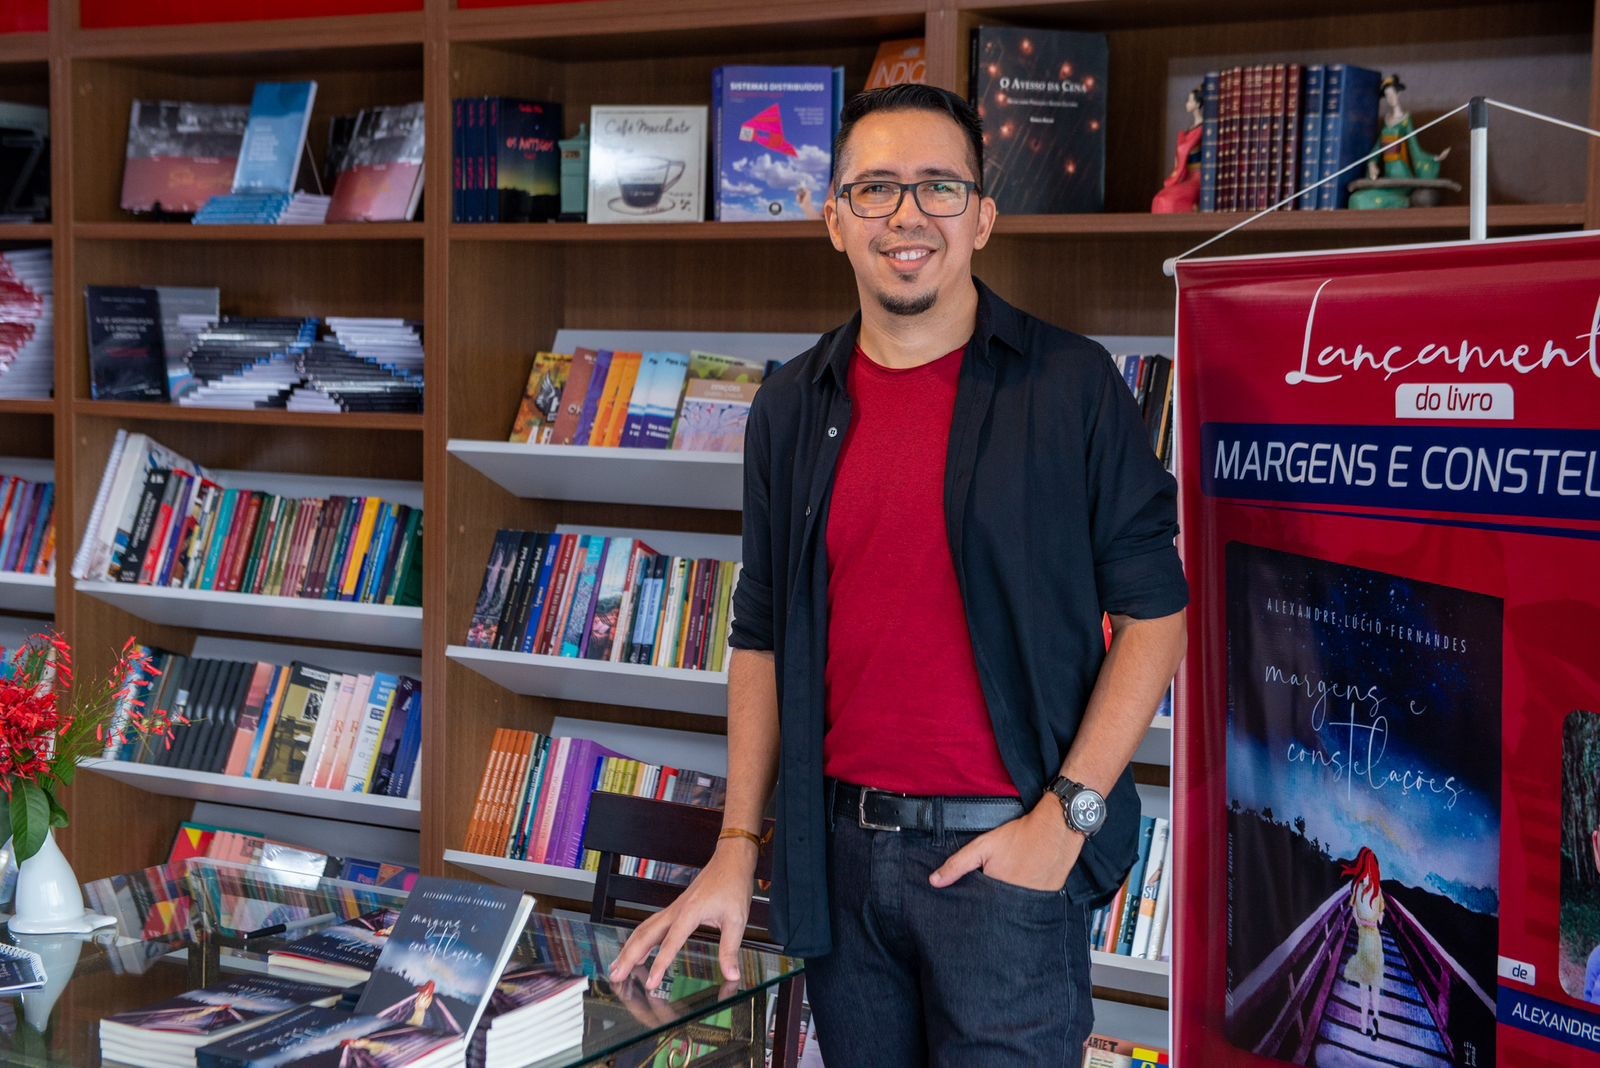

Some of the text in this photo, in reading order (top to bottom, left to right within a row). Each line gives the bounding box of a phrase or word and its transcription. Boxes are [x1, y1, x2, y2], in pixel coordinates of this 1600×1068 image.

[730, 81, 824, 92] SISTEMAS DISTRIBUÍDOS
[1000, 77, 1009, 89] O
[604, 117, 691, 137] Café Macchiato
[519, 137, 555, 152] ANTIGOS
[1415, 384, 1493, 412] do livro
[1214, 440, 1600, 498] MARGENS E CONSTEL
[1267, 598, 1467, 654] ALEXANDRE LÚCIO FERNANDES
[1265, 664, 1386, 732] margens
[1410, 699, 1426, 715] e
[1287, 702, 1465, 811] constelações
[1511, 964, 1528, 980] de
[1512, 1002, 1600, 1043] ALEXANDRE
